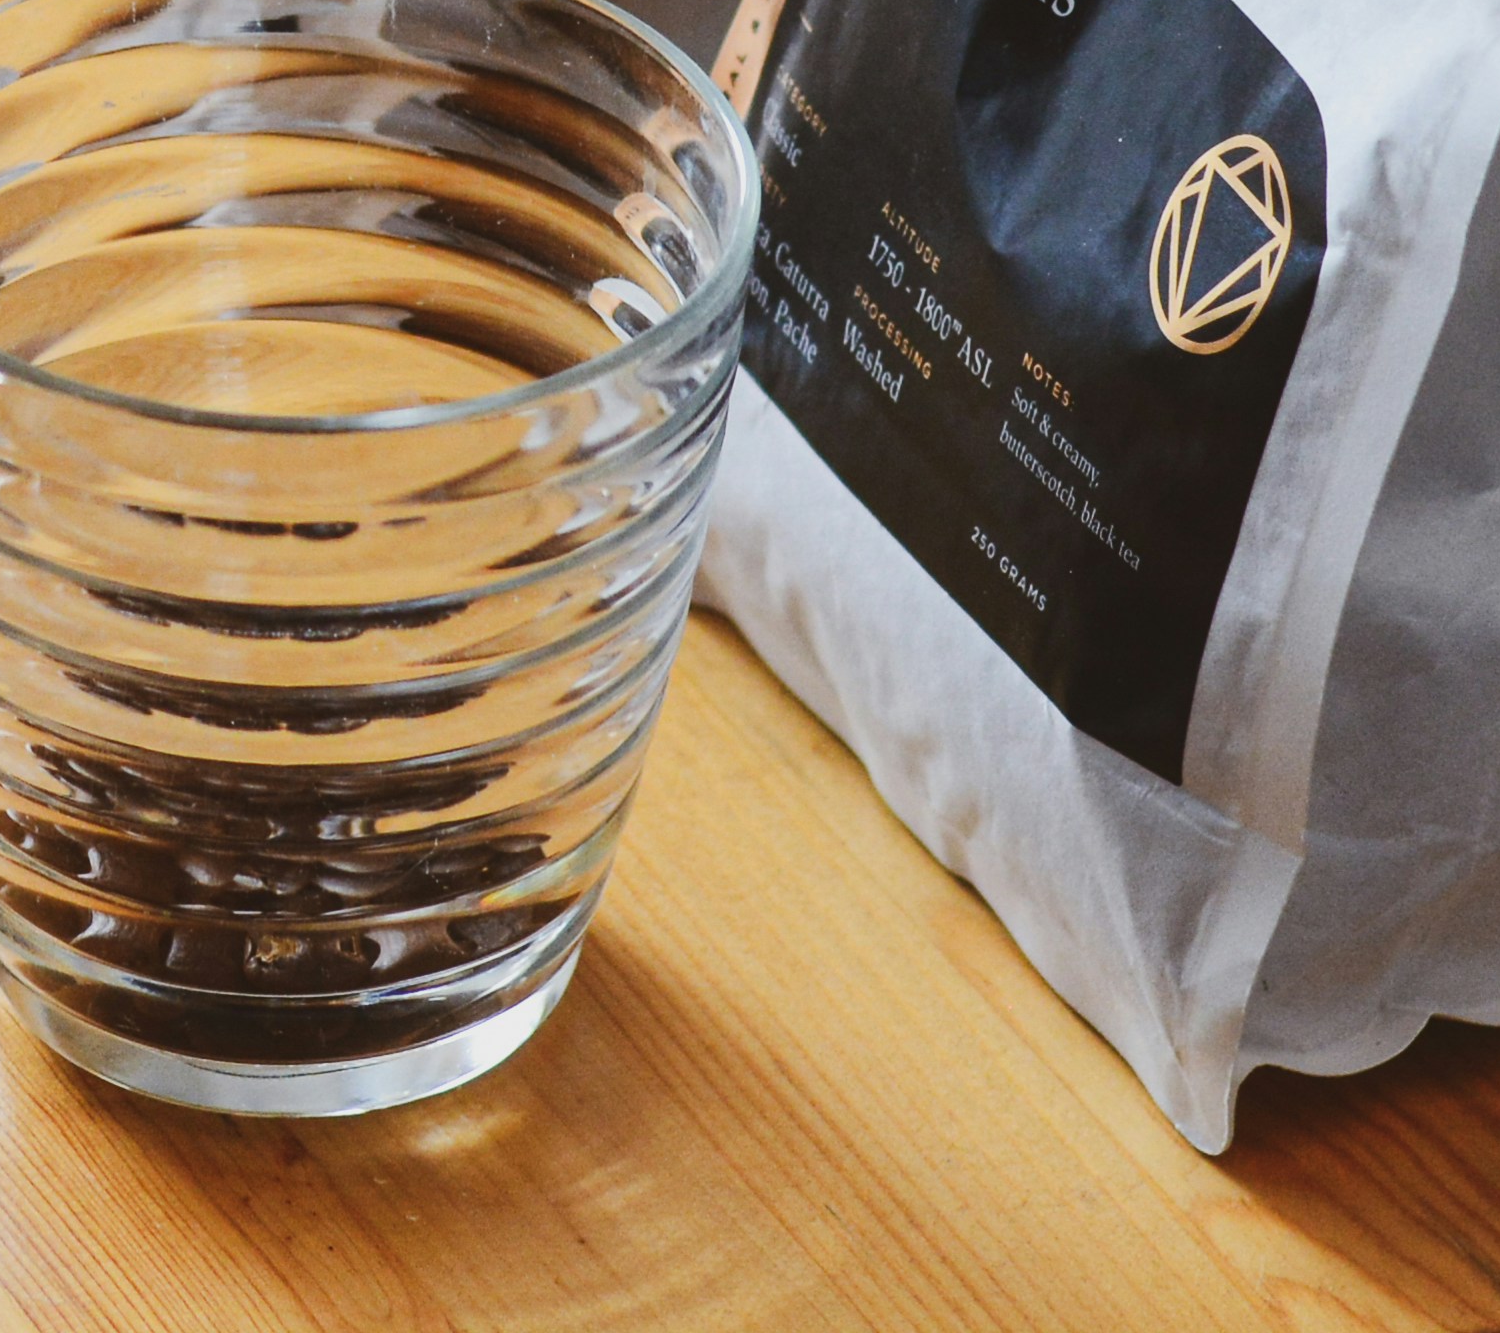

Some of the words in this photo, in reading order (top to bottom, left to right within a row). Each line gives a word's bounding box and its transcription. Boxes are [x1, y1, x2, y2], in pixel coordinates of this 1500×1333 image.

[881, 201, 942, 274] ALTITUDE
[775, 242, 829, 322] Caturra
[868, 234, 905, 287] 1750
[957, 336, 993, 389] ASL
[774, 299, 818, 364] Pache
[842, 317, 904, 403] Washed
[854, 284, 933, 380] PROCESSING
[1011, 386, 1037, 424] Soft
[1039, 413, 1051, 438] &
[1052, 431, 1100, 488] creamy,
[999, 420, 1077, 516] butterscotch,
[1081, 500, 1116, 550] black
[1118, 540, 1141, 571] tea
[971, 525, 996, 560] 250
[999, 555, 1047, 612] GRAMS
